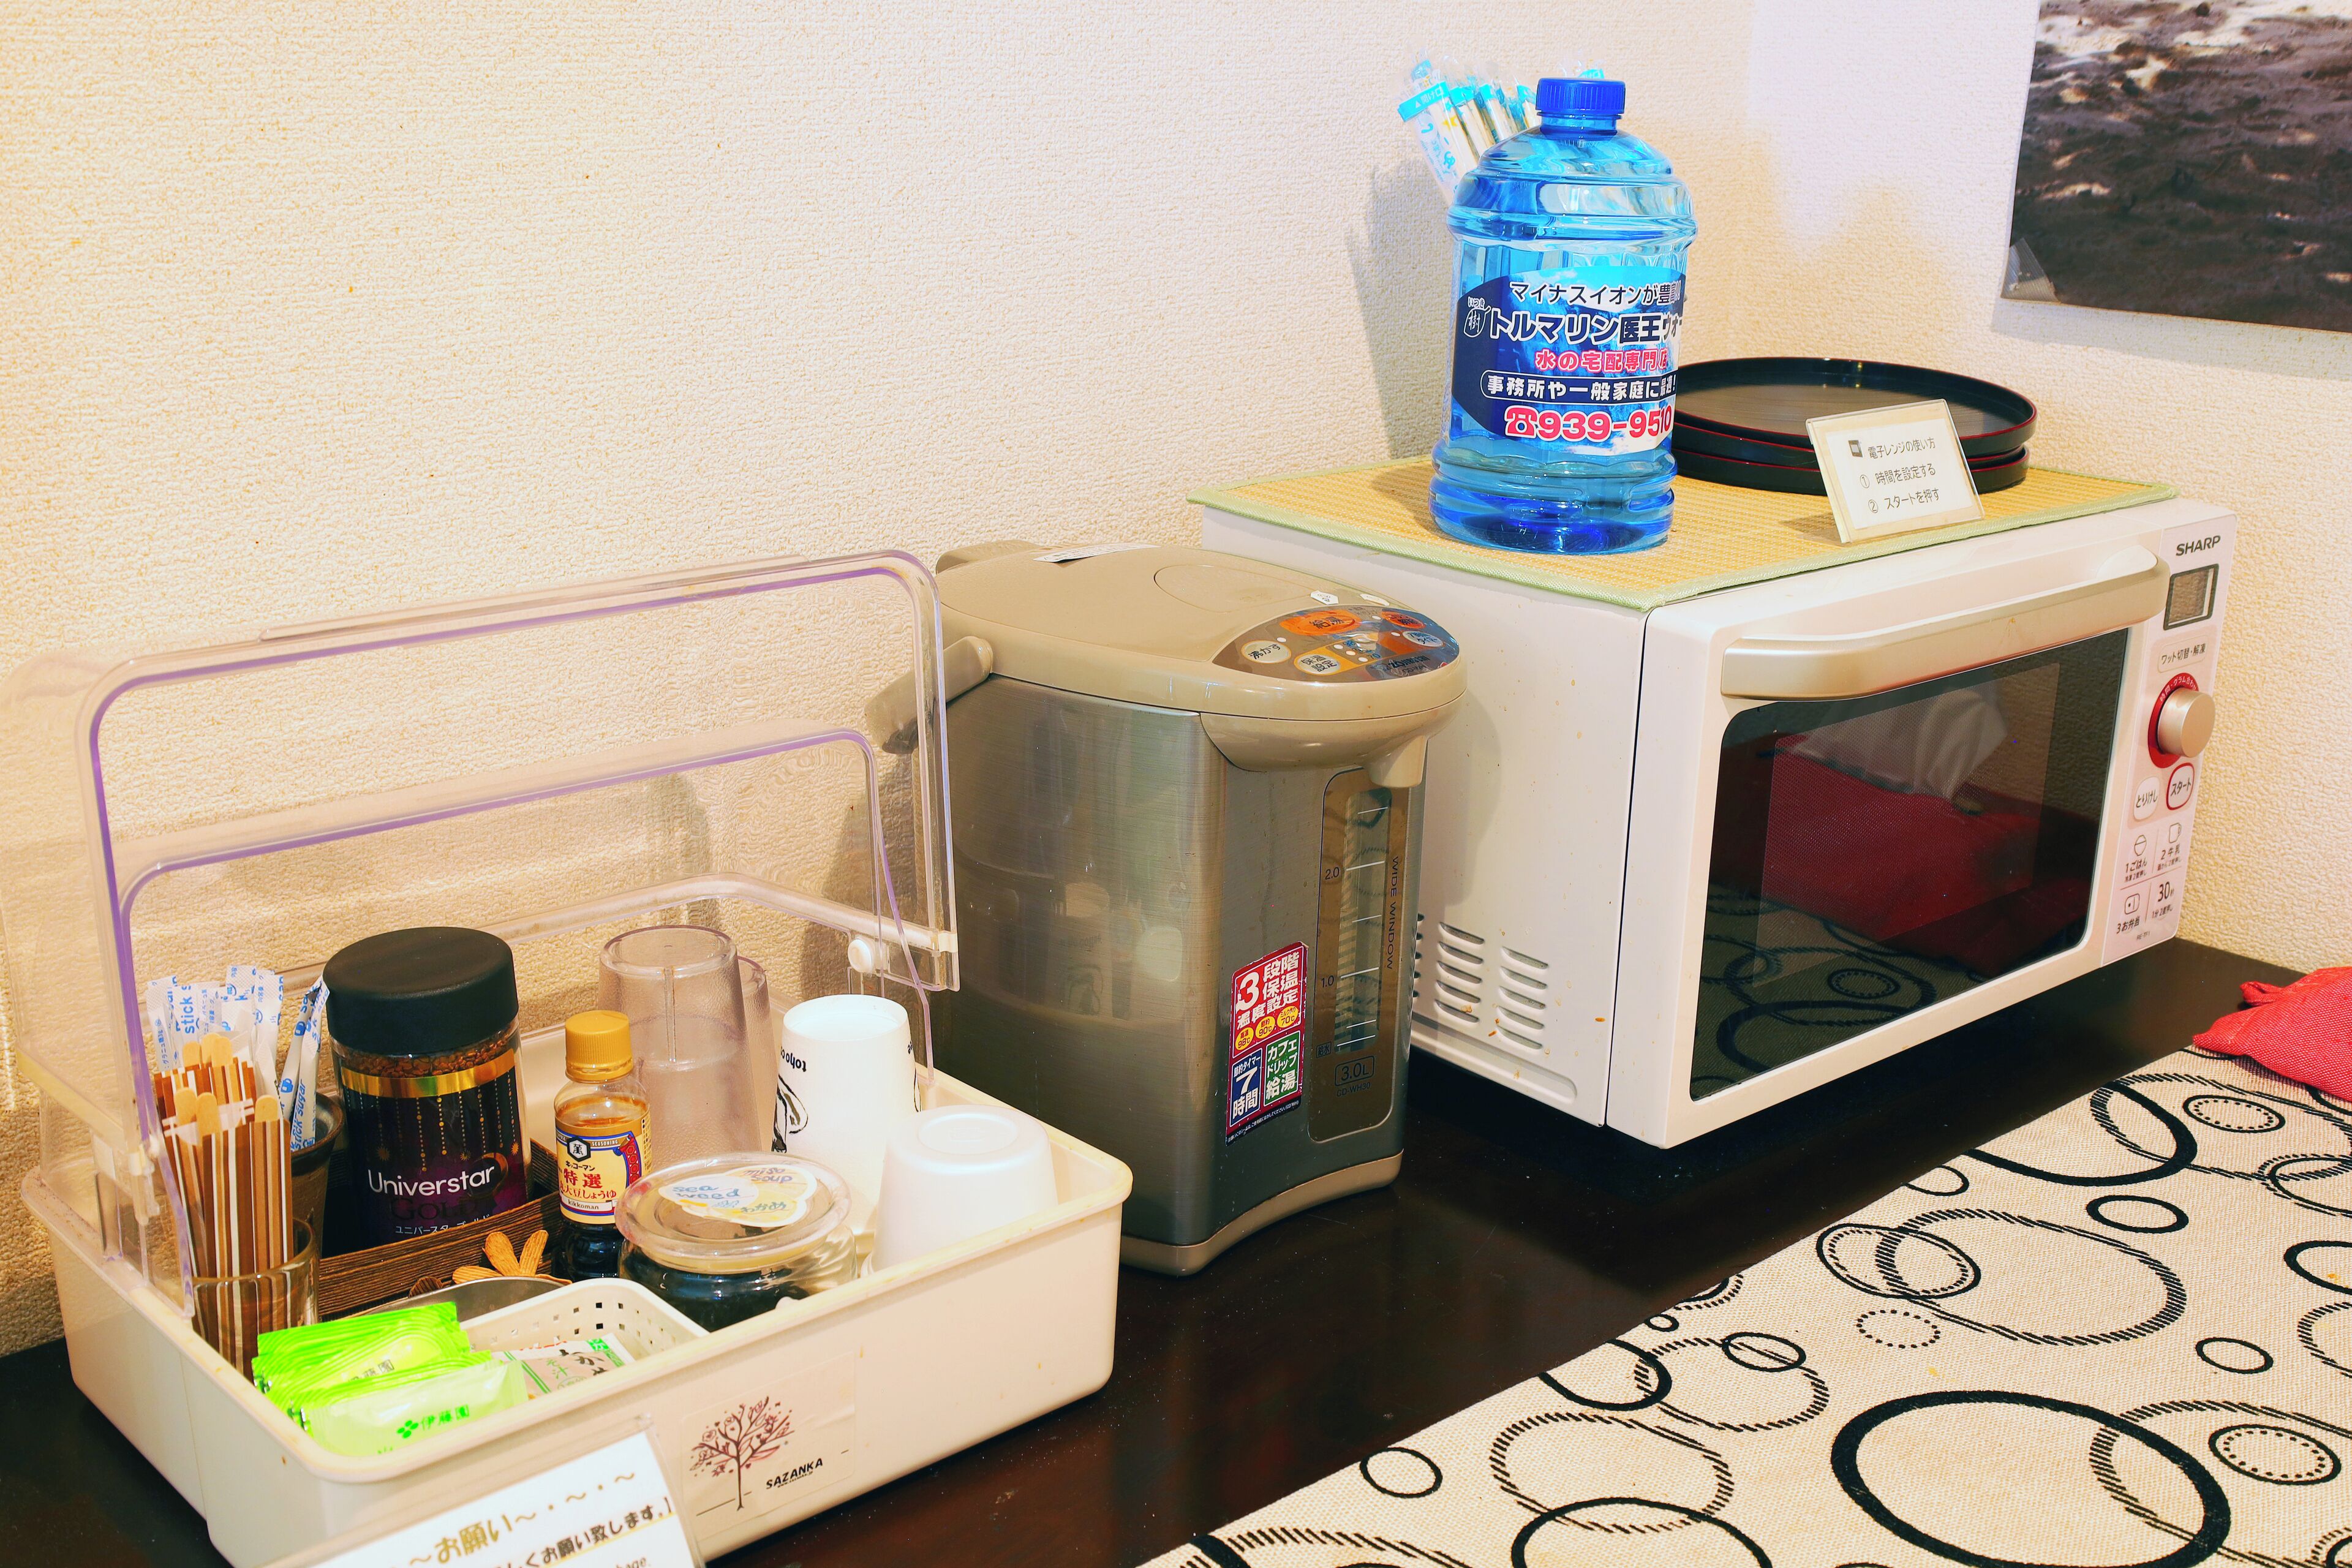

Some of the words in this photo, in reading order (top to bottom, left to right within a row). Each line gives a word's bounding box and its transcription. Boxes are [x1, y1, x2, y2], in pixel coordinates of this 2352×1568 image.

[1535, 349, 1668, 372] 水の宅配専門店
[1868, 437, 1936, 459] 電子レンジの使い方
[1875, 463, 1936, 485] 時間を設定する
[1885, 488, 1940, 510] スタートを押す
[2176, 535, 2221, 556] SHARP
[1248, 643, 1281, 660] 沸かす
[1311, 660, 1338, 672] 設定
[2170, 777, 2192, 796] スタート
[2136, 789, 2158, 809] とりけし
[1325, 867, 1340, 880] 2.0
[1390, 856, 1399, 897] WIDE
[1386, 902, 1396, 970] WINDOW
[1262, 970, 1298, 1000] 保温
[1321, 976, 1335, 988] 1.0
[179, 996, 195, 1034] stick
[1237, 988, 1298, 1030] 温度設定
[1267, 1037, 1297, 1063] カフェ
[1267, 1052, 1298, 1077] ドリップ
[1341, 1060, 1370, 1082] 3.0L
[1265, 1069, 1297, 1100] 給湯
[1232, 1087, 1259, 1120] 時間
[565, 1160, 596, 1172] キッコーマン
[743, 1167, 786, 1176] miso
[368, 1166, 495, 1196] Universtar
[564, 1167, 603, 1189] 特選
[751, 1174, 794, 1185] soup
[567, 1199, 600, 1210] kikkoman
[676, 1188, 741, 1200] weed
[766, 1458, 823, 1490] SAZANKA
